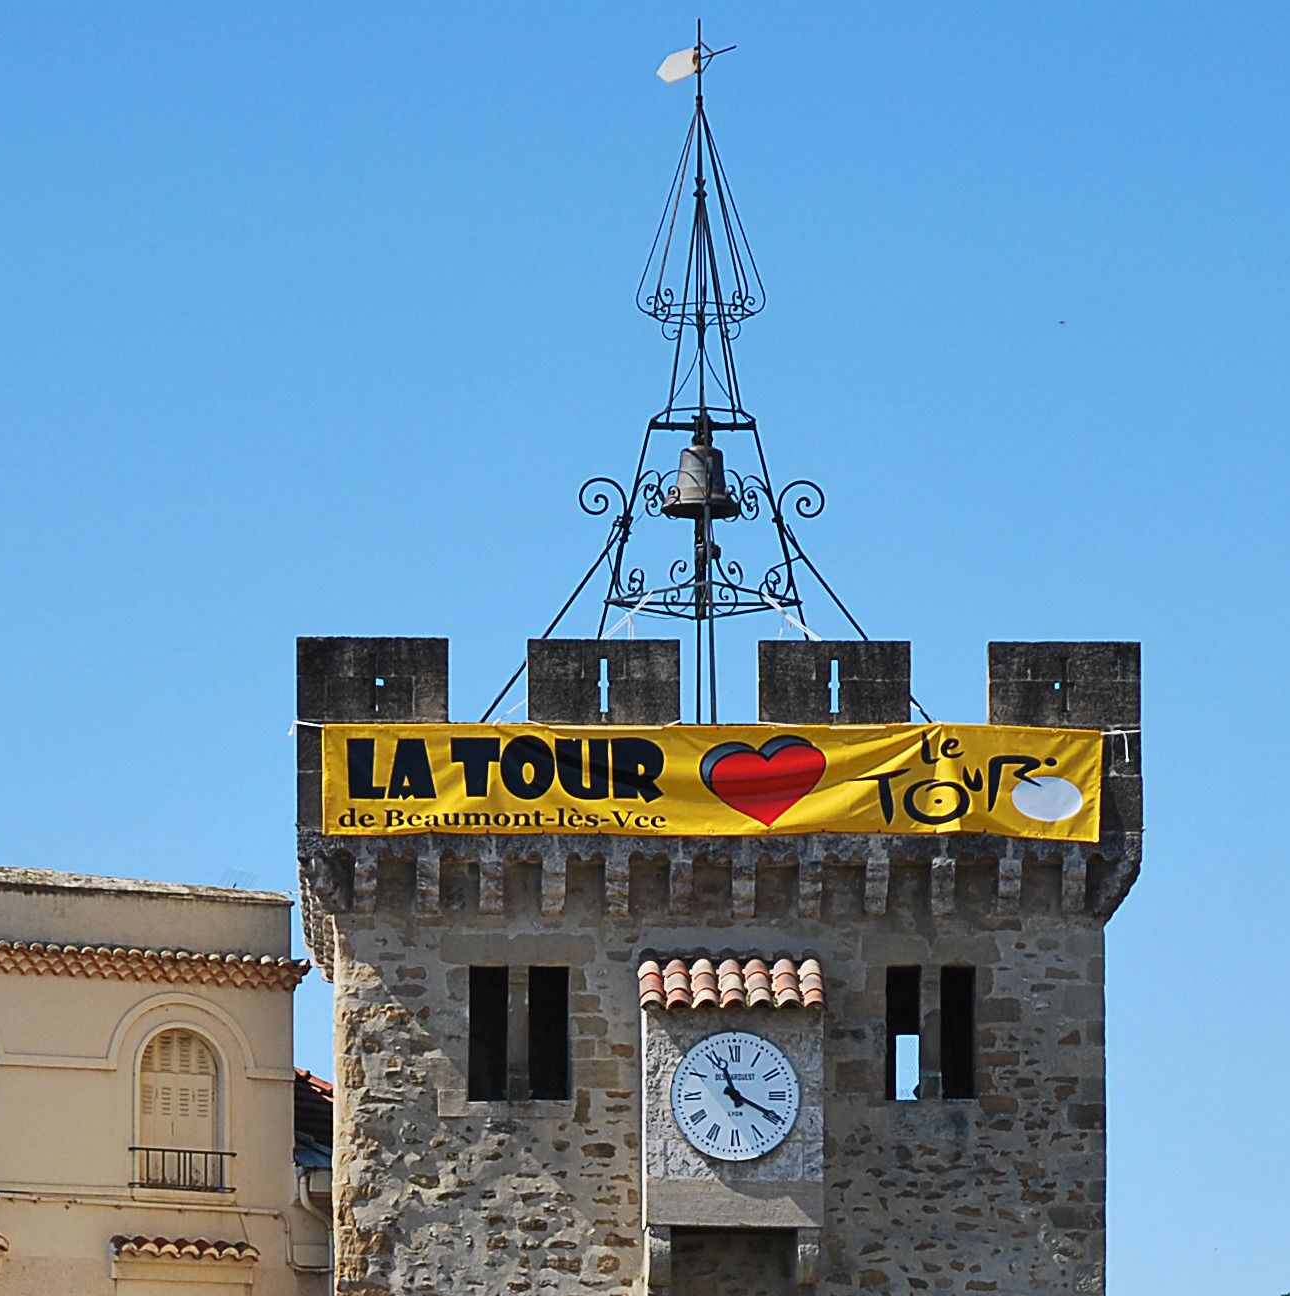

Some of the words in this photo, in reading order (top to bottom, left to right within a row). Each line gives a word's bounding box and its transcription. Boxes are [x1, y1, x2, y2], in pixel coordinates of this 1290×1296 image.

[346, 738, 437, 801] LA
[450, 734, 665, 804] TOUR
[338, 807, 376, 828] de
